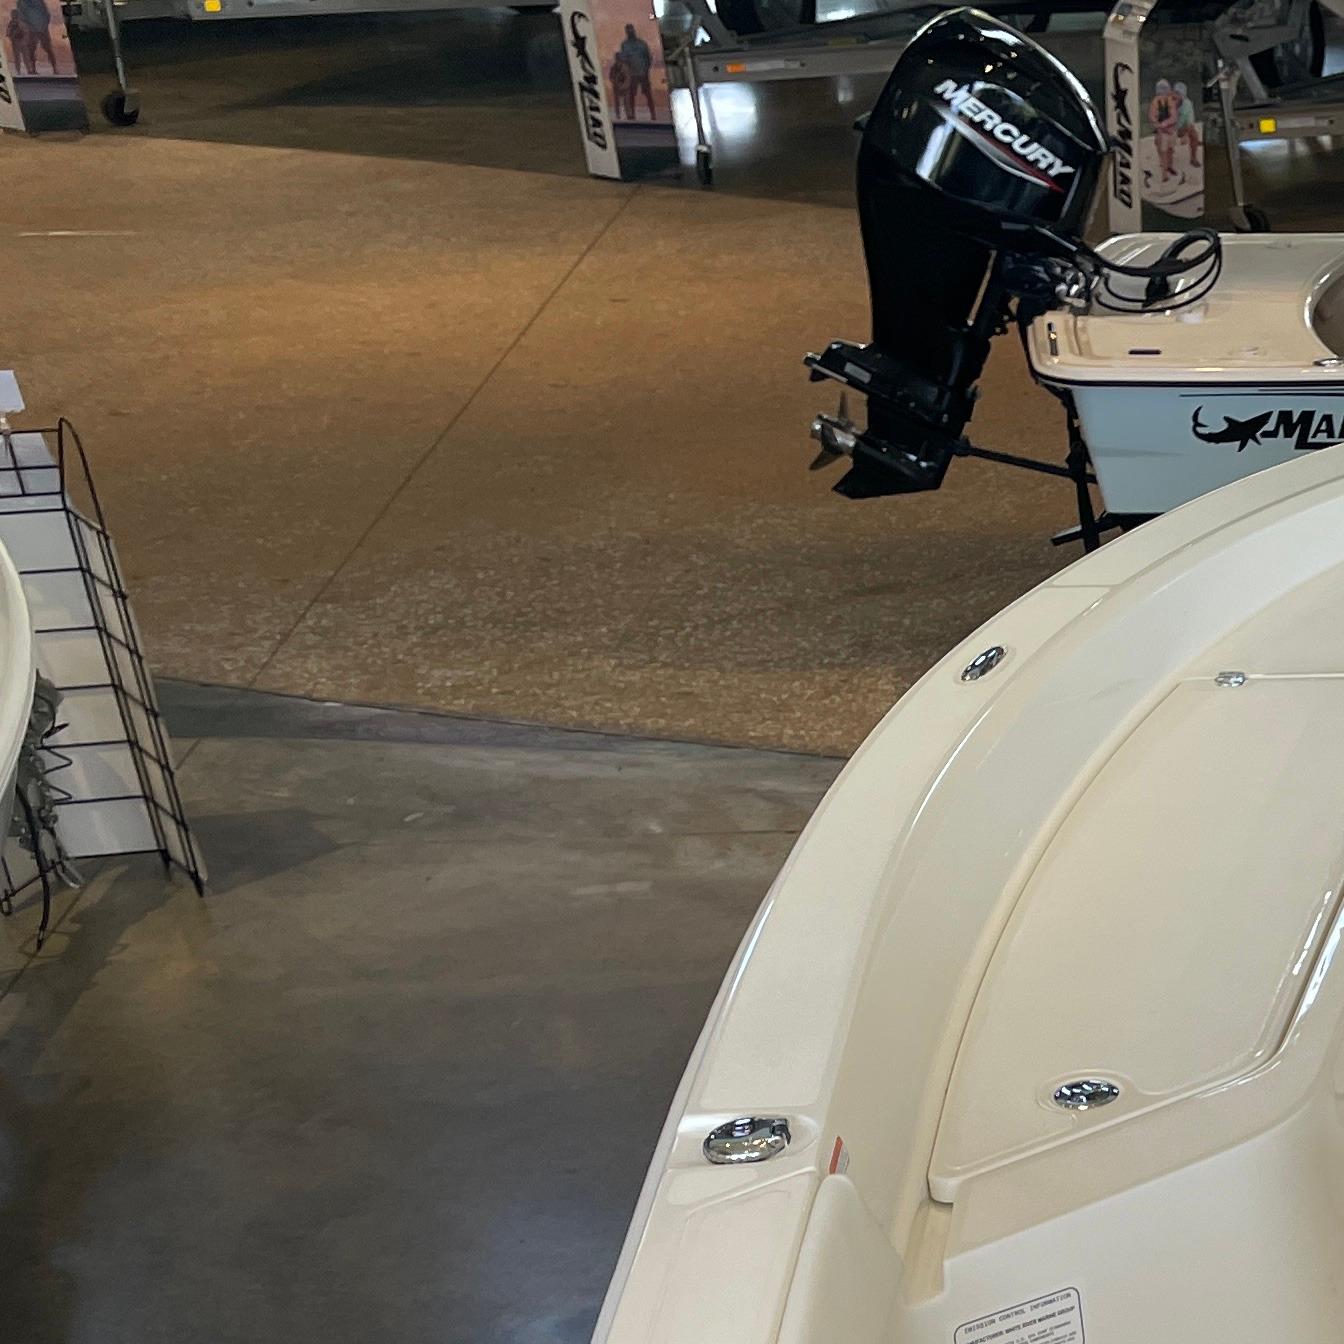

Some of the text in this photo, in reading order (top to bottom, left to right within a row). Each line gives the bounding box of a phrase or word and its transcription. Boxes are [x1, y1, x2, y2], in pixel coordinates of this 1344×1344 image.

[933, 79, 1076, 176] MERCURY
[998, 1308, 1026, 1322] CONTROL
[1029, 1293, 1072, 1311] INFORMATION
